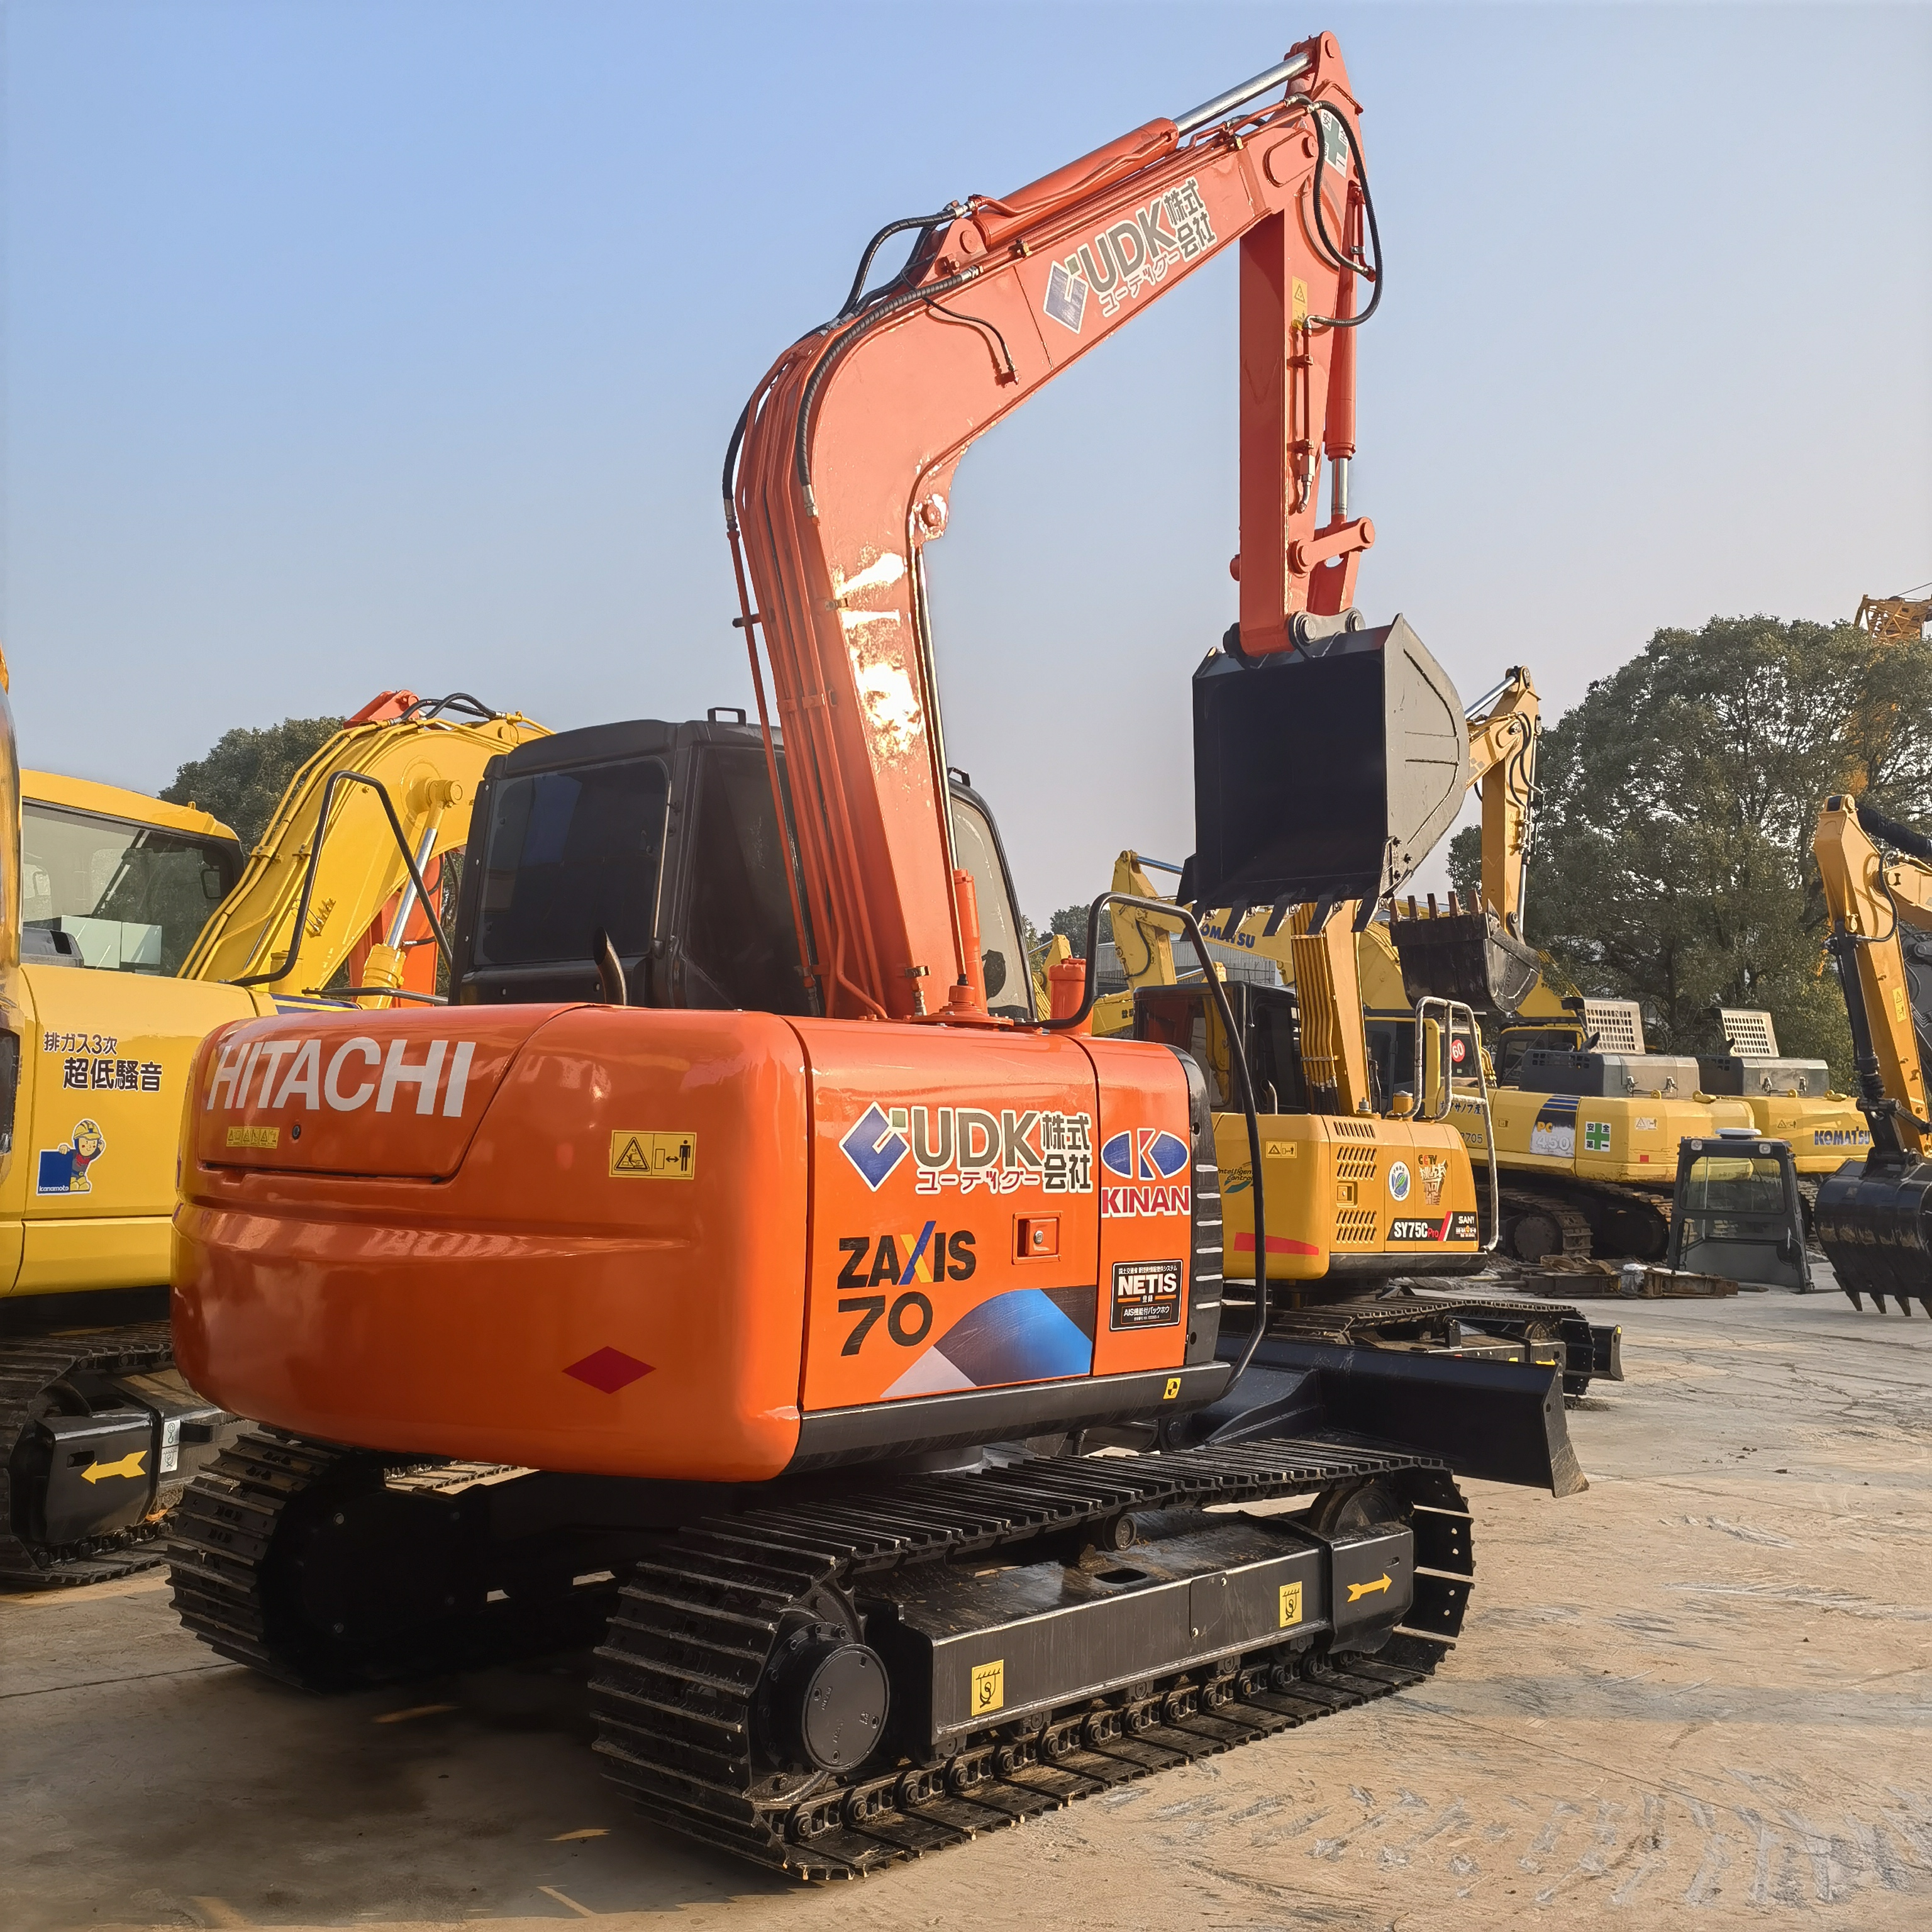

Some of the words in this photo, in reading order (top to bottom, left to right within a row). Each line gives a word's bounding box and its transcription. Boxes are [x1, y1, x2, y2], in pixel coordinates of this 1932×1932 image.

[1080, 199, 1177, 292] UDK
[43, 1031, 118, 1055] 排ガス3次
[1452, 1042, 1464, 1059] 60
[63, 1057, 162, 1092] 超低騒音
[207, 1036, 476, 1117] HITACHI
[913, 1108, 1042, 1168] UDK
[1536, 1121, 1553, 1133] PC
[1814, 1126, 1870, 1145] KOMATSU
[1536, 1136, 1570, 1151] 450
[1418, 1154, 1437, 1165] CCTV
[1218, 1167, 1252, 1176] Intelligen
[1101, 1186, 1189, 1214] KINAN
[1394, 1222, 1428, 1238] SY75C
[1428, 1228, 1439, 1238] Pro
[837, 1221, 977, 1289] ZAXIS
[1118, 1273, 1177, 1296] NETIS
[838, 1291, 933, 1357] 70
